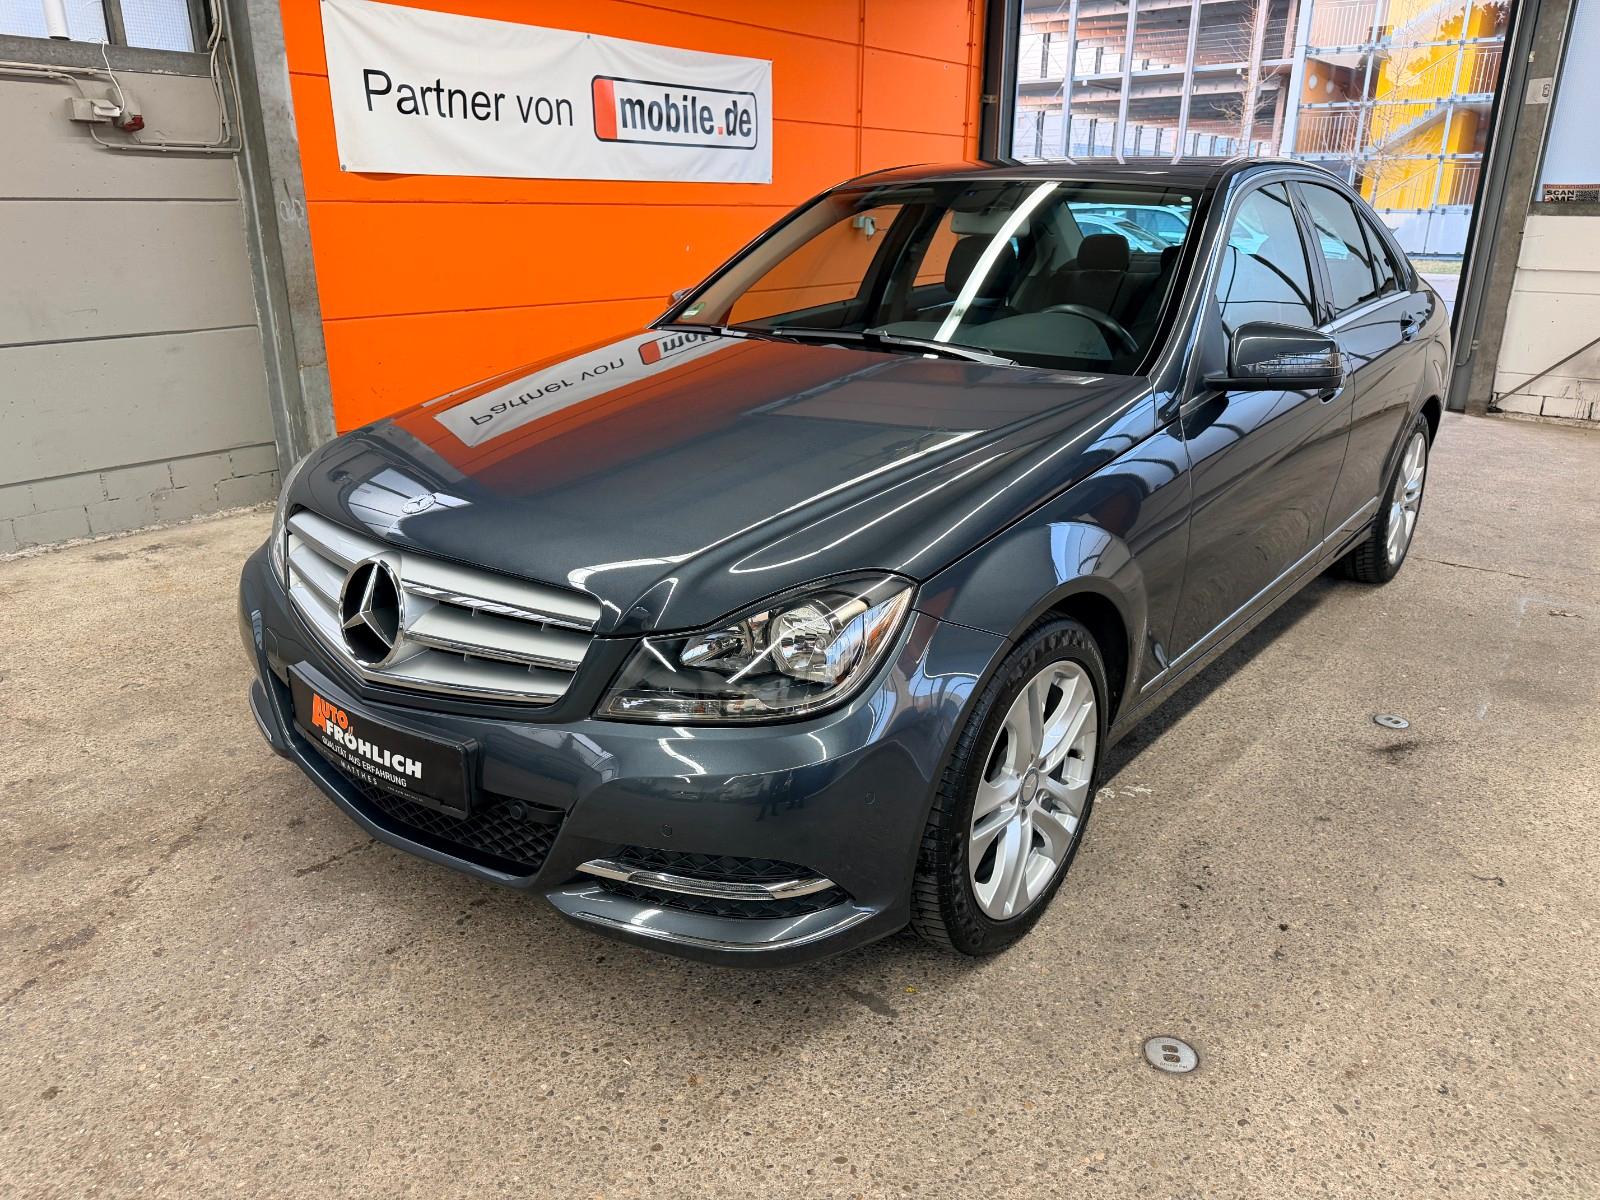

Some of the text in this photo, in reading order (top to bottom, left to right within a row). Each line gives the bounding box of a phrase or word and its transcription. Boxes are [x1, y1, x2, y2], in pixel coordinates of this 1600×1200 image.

[362, 69, 752, 137] Partner von mobile.de
[312, 693, 348, 732] AUTO
[326, 720, 422, 779] FRÖHLICH
[349, 754, 361, 766] AUS
[362, 760, 407, 787] ERFAHRUNG
